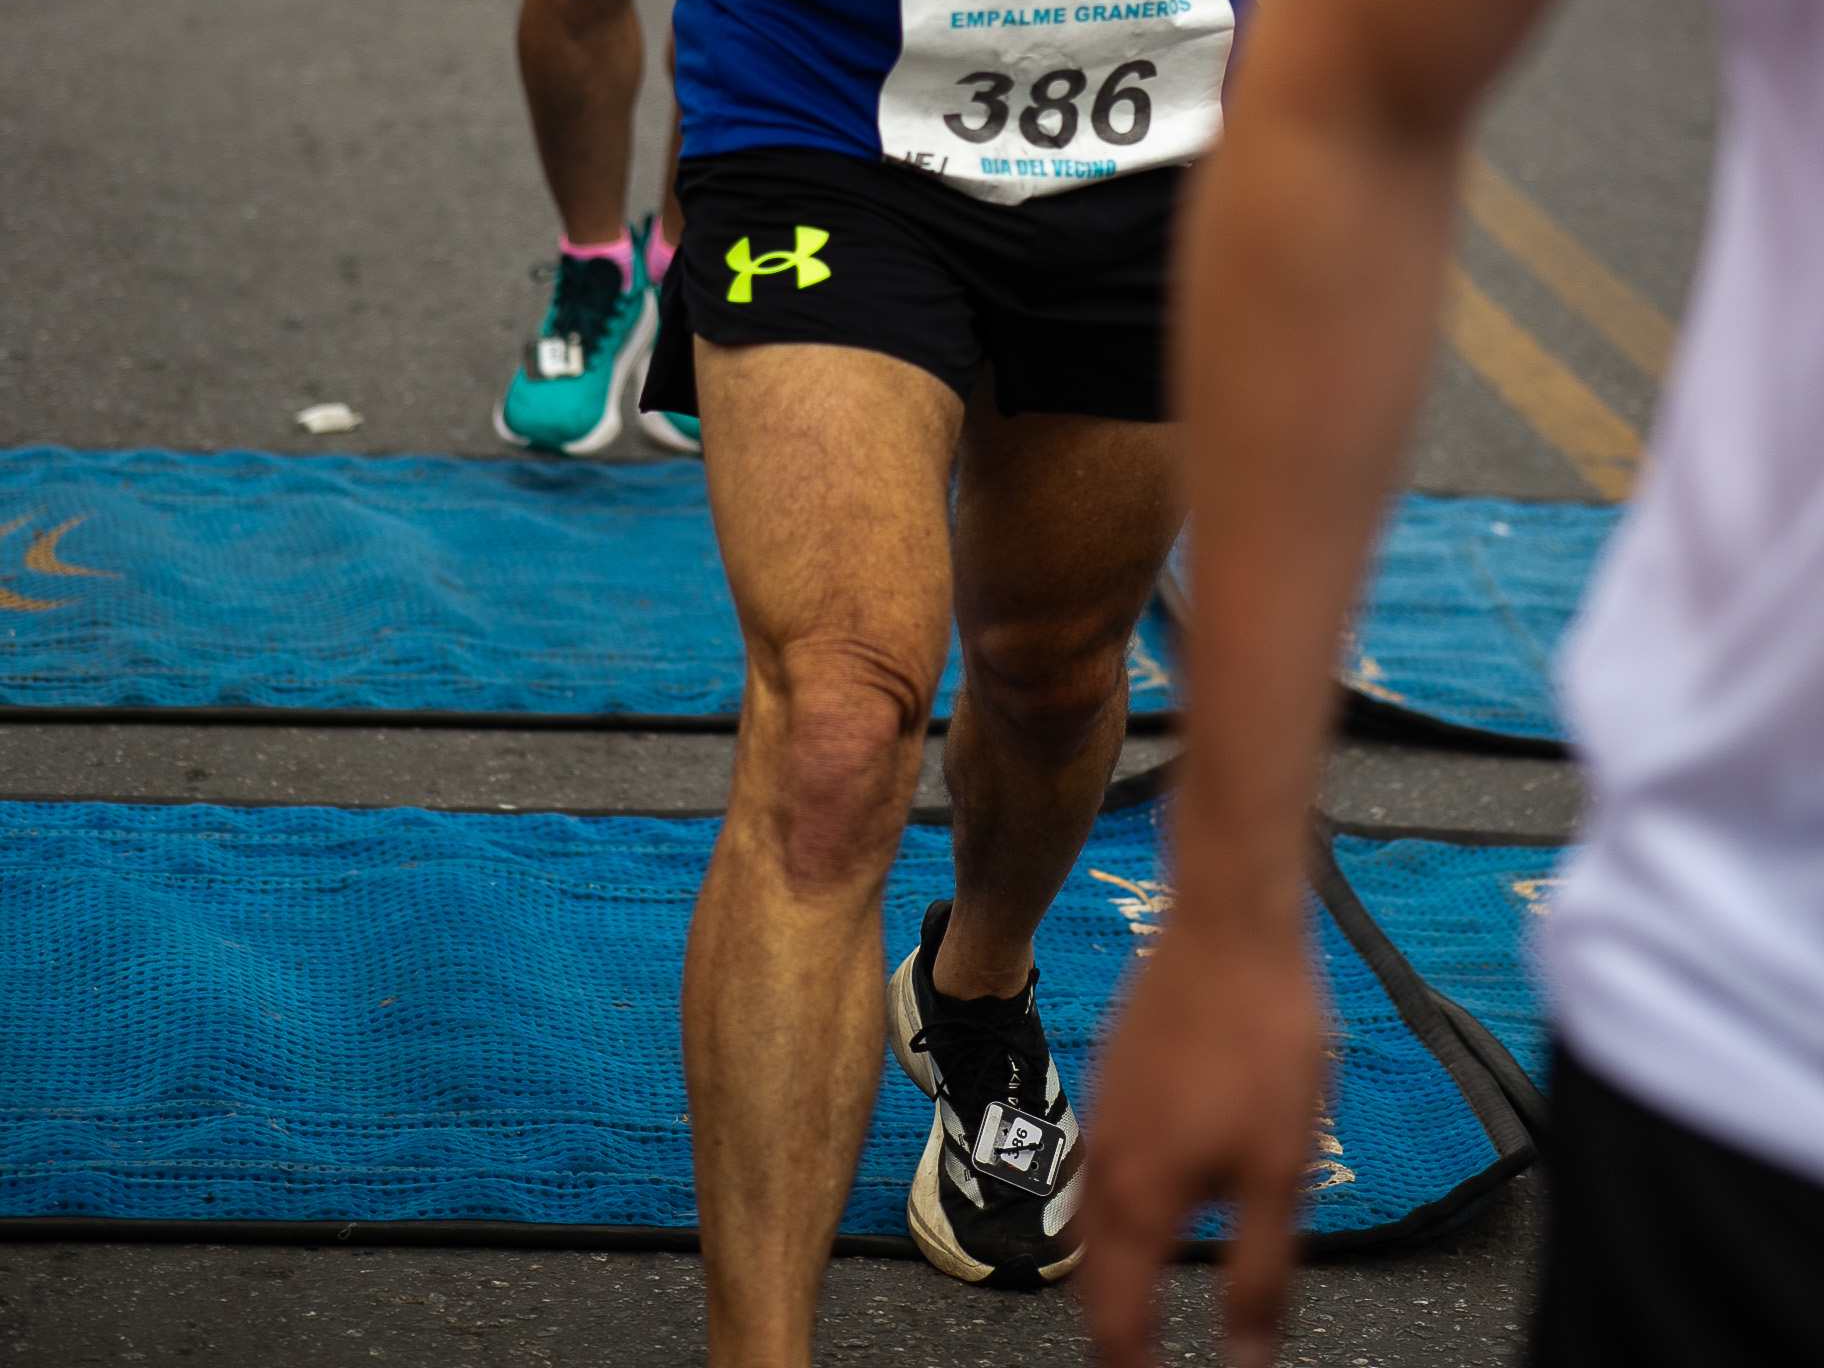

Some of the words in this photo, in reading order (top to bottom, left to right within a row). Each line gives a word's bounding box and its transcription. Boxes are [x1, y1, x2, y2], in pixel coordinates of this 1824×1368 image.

[950, 7, 1066, 29] EMPALME
[942, 59, 1158, 149] 386
[981, 157, 1012, 175] DIA
[1015, 158, 1047, 177] DEL
[1051, 159, 1117, 179] VECINO
